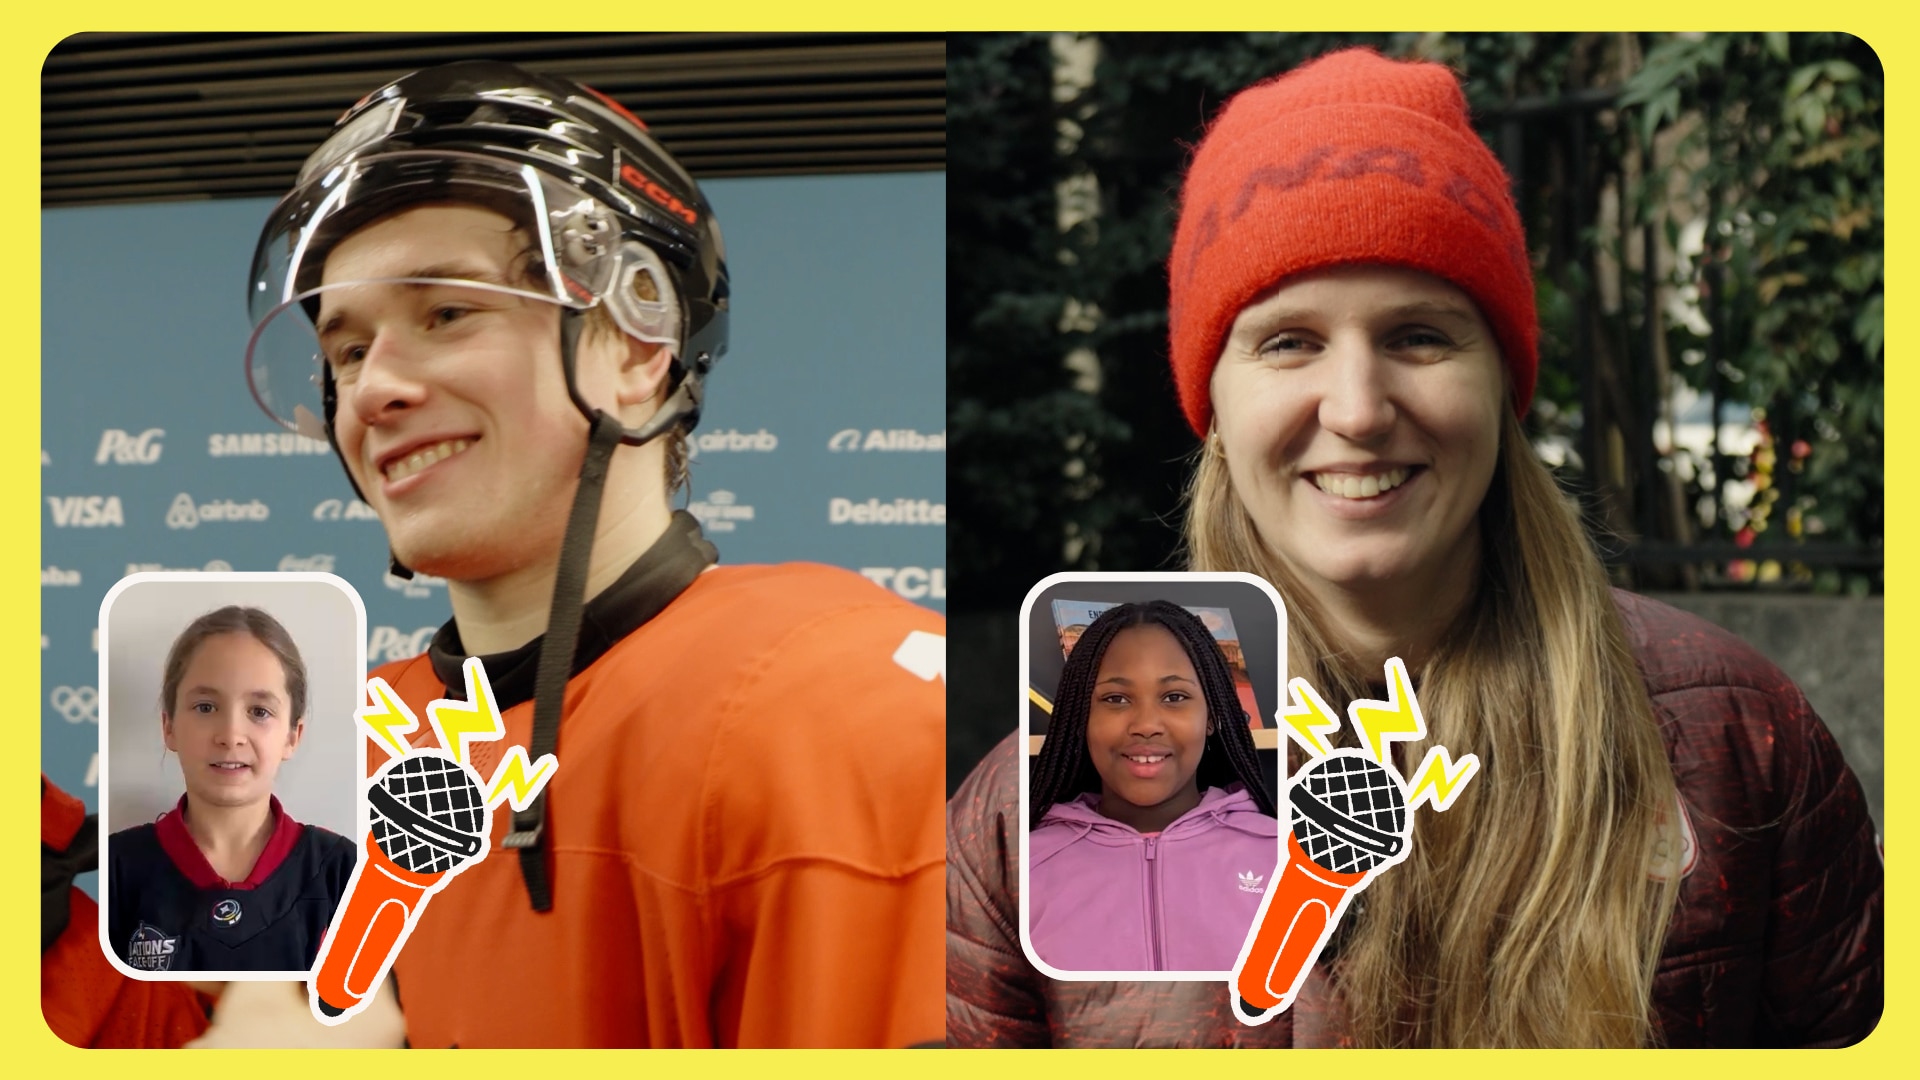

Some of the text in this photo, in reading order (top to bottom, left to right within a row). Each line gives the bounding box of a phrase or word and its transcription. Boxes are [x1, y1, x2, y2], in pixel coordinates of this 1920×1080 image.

[620, 163, 698, 225] CCM
[95, 428, 165, 466] P&G
[699, 428, 779, 452] airbnb
[48, 495, 125, 528] VISA
[198, 498, 271, 522] airbnb
